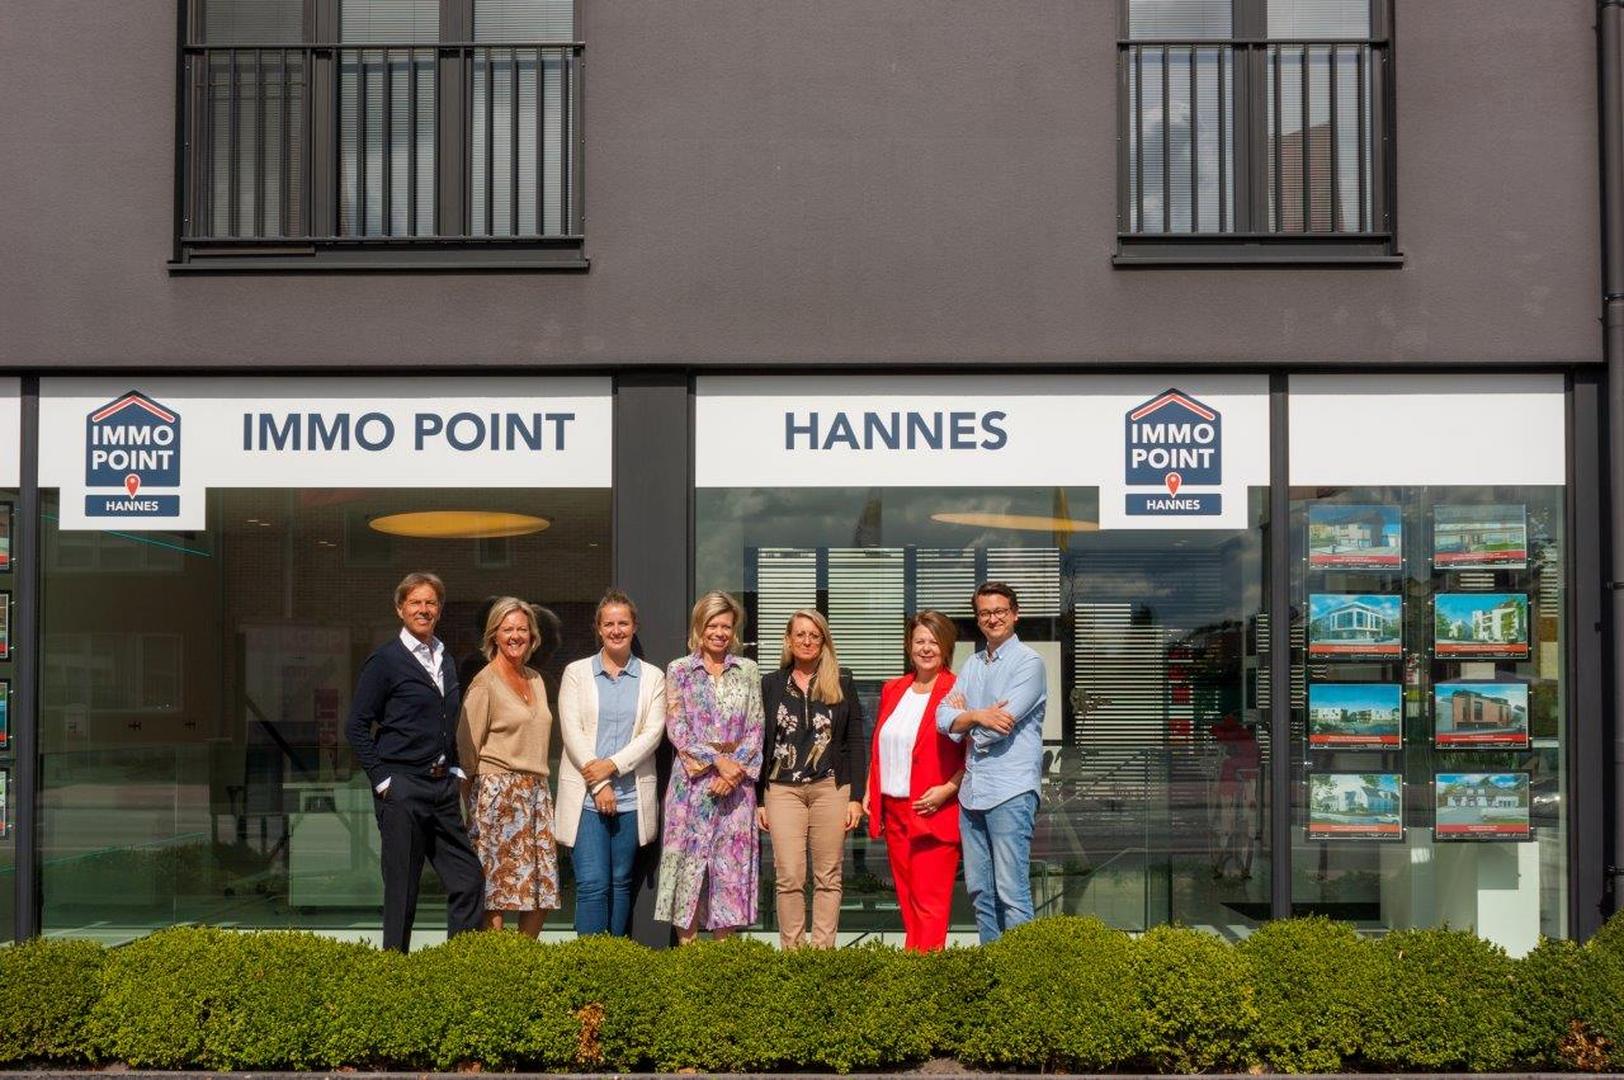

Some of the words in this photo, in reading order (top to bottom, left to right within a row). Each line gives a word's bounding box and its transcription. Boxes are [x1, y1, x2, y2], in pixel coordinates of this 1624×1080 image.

[92, 424, 174, 446] IMMO
[244, 413, 394, 451] IMMO
[415, 413, 575, 451] POINT
[786, 411, 1008, 450] HANNES
[1132, 423, 1215, 444] IMMO
[92, 449, 174, 471] POINT
[1132, 447, 1215, 469] POINT
[106, 500, 159, 512] HANNES
[1146, 499, 1201, 511] HANNES
